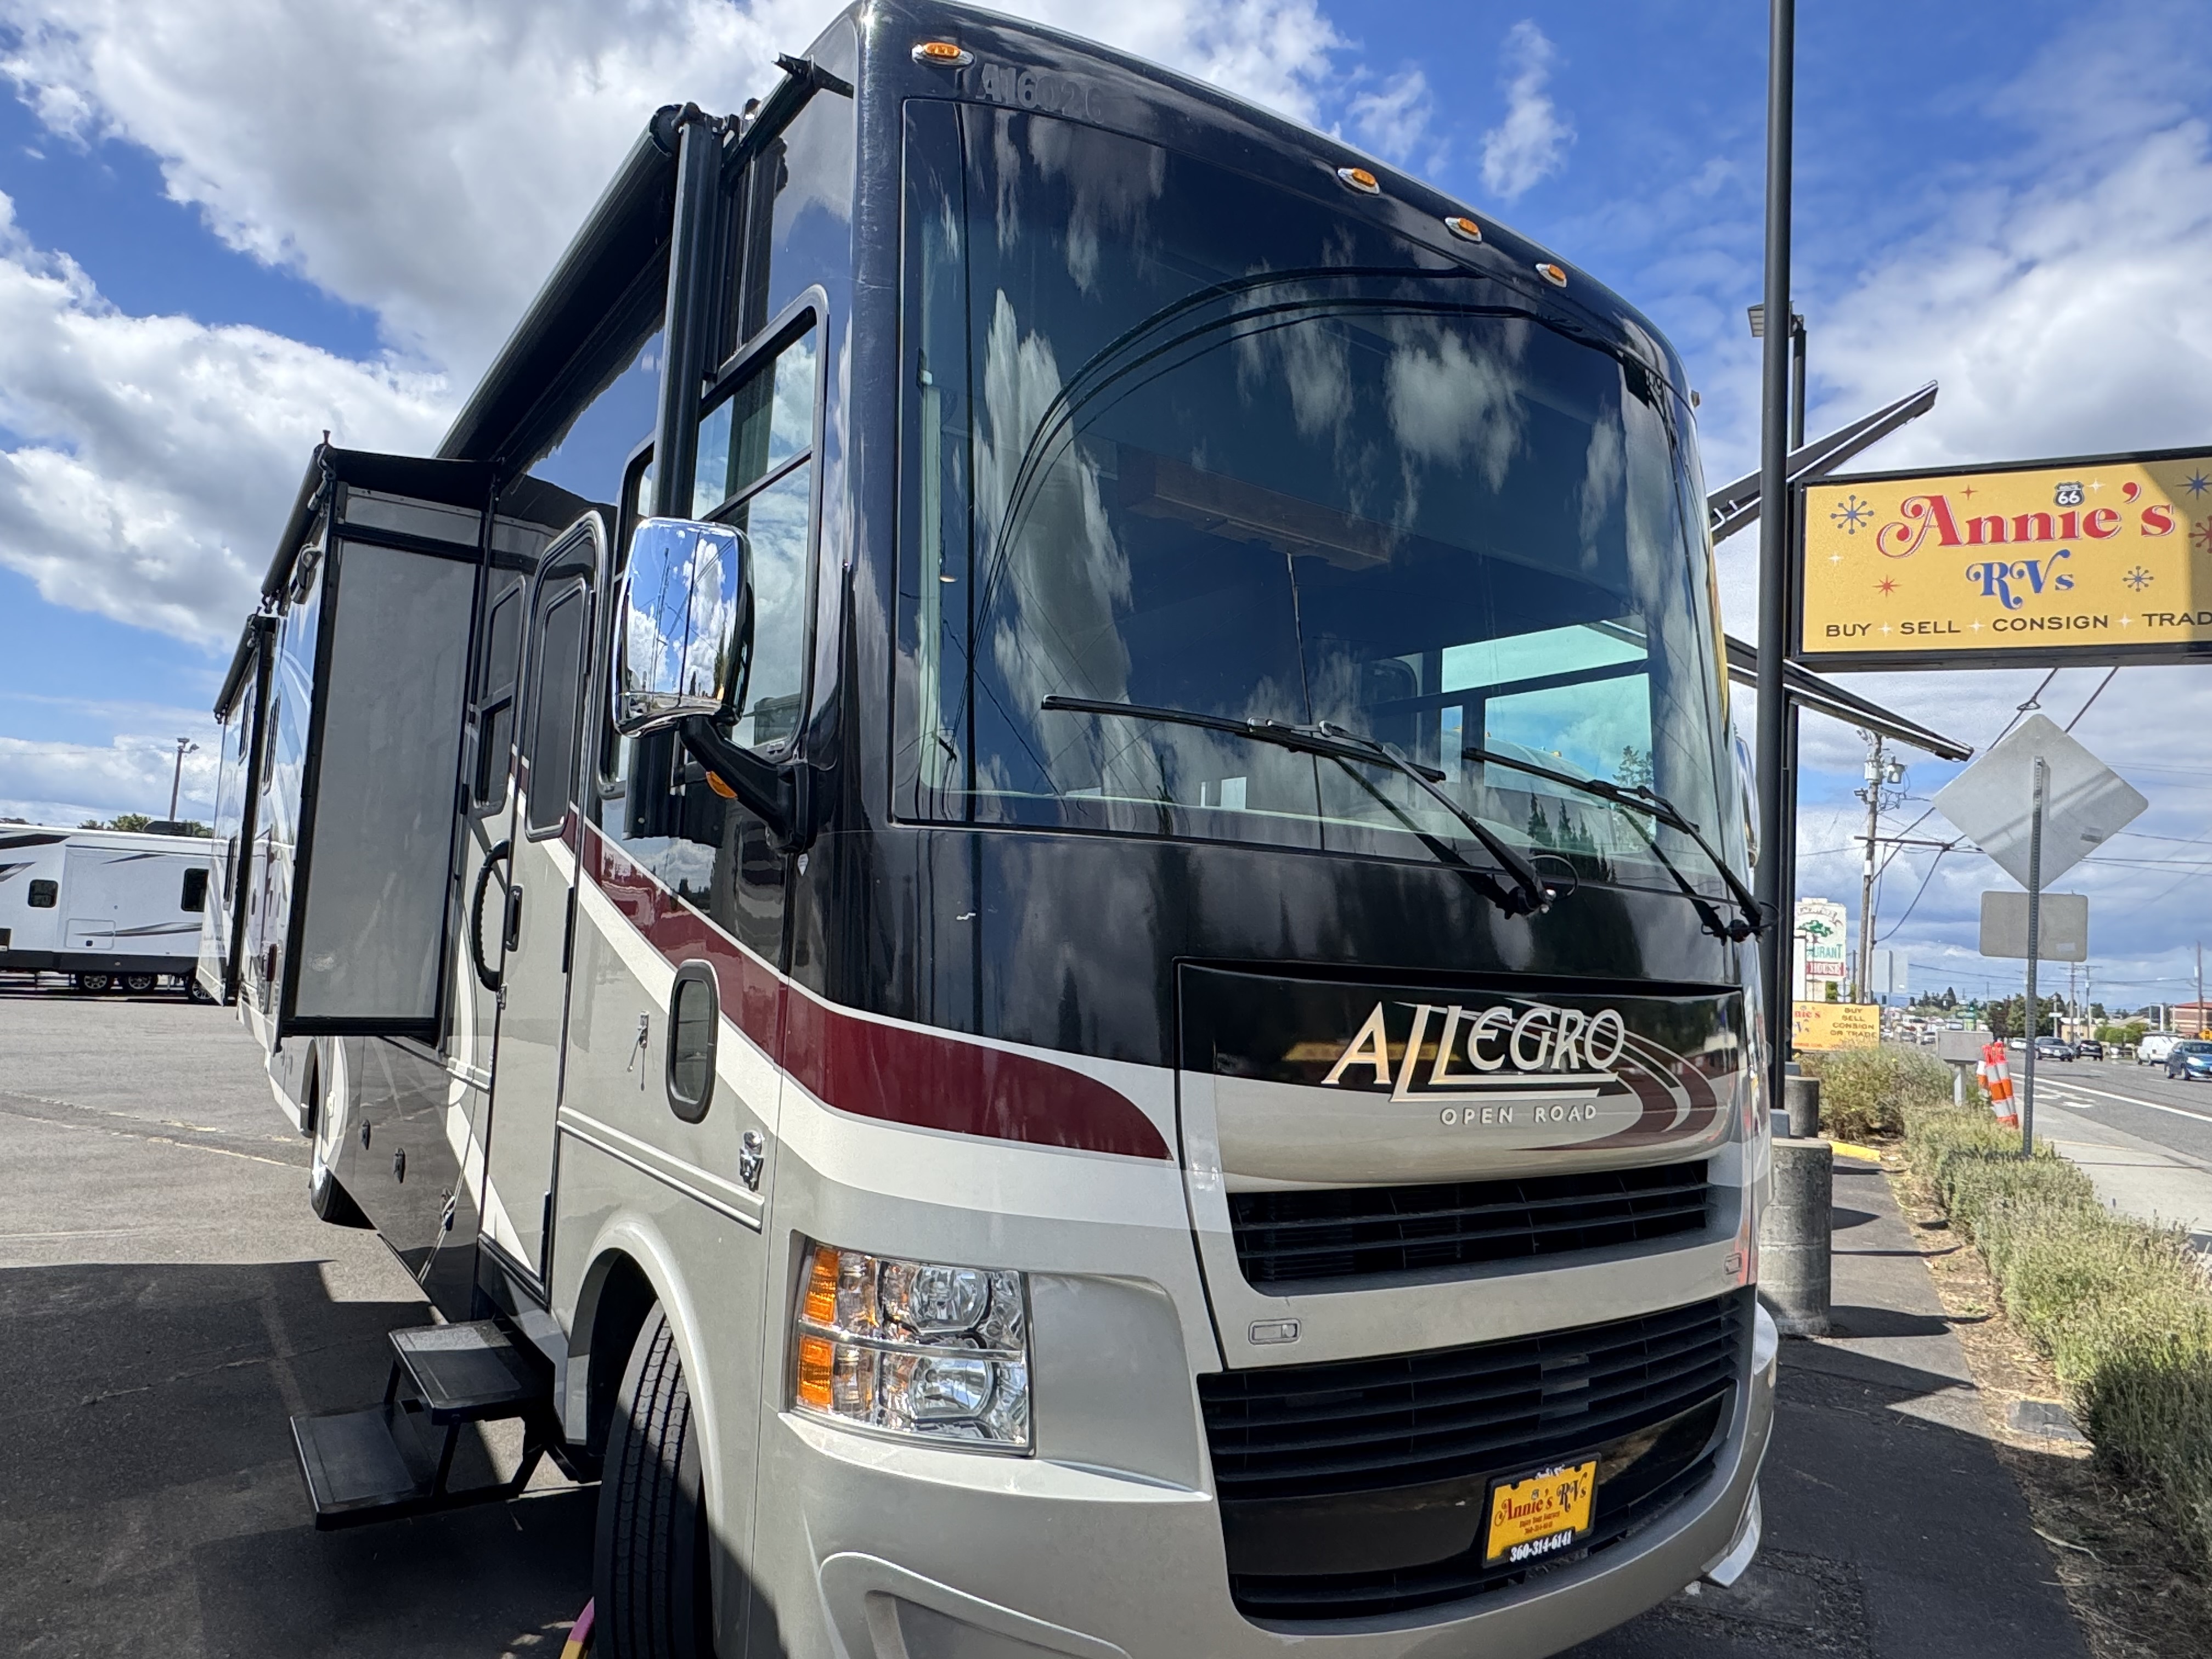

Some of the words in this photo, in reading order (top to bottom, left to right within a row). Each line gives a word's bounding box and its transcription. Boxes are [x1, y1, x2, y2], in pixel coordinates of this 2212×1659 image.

[2058, 490, 2080, 505] 66
[1876, 482, 2177, 558] Annie's
[1966, 549, 2075, 610] RVs
[1826, 623, 1872, 637] BUY
[1900, 620, 1961, 635] SELL
[1993, 614, 2108, 632] CONSIGN
[2142, 612, 2212, 627] TRAD
[1846, 1030, 1877, 1039] TRADE
[1321, 1001, 1624, 1103] ALLEGRO
[1440, 1107, 1514, 1126] OPEN
[1534, 1104, 1598, 1123] ROAD
[1494, 1488, 1553, 1527] Annie's
[1556, 1472, 1588, 1513] RVs
[1510, 1530, 1572, 1562] 360-314-6141
